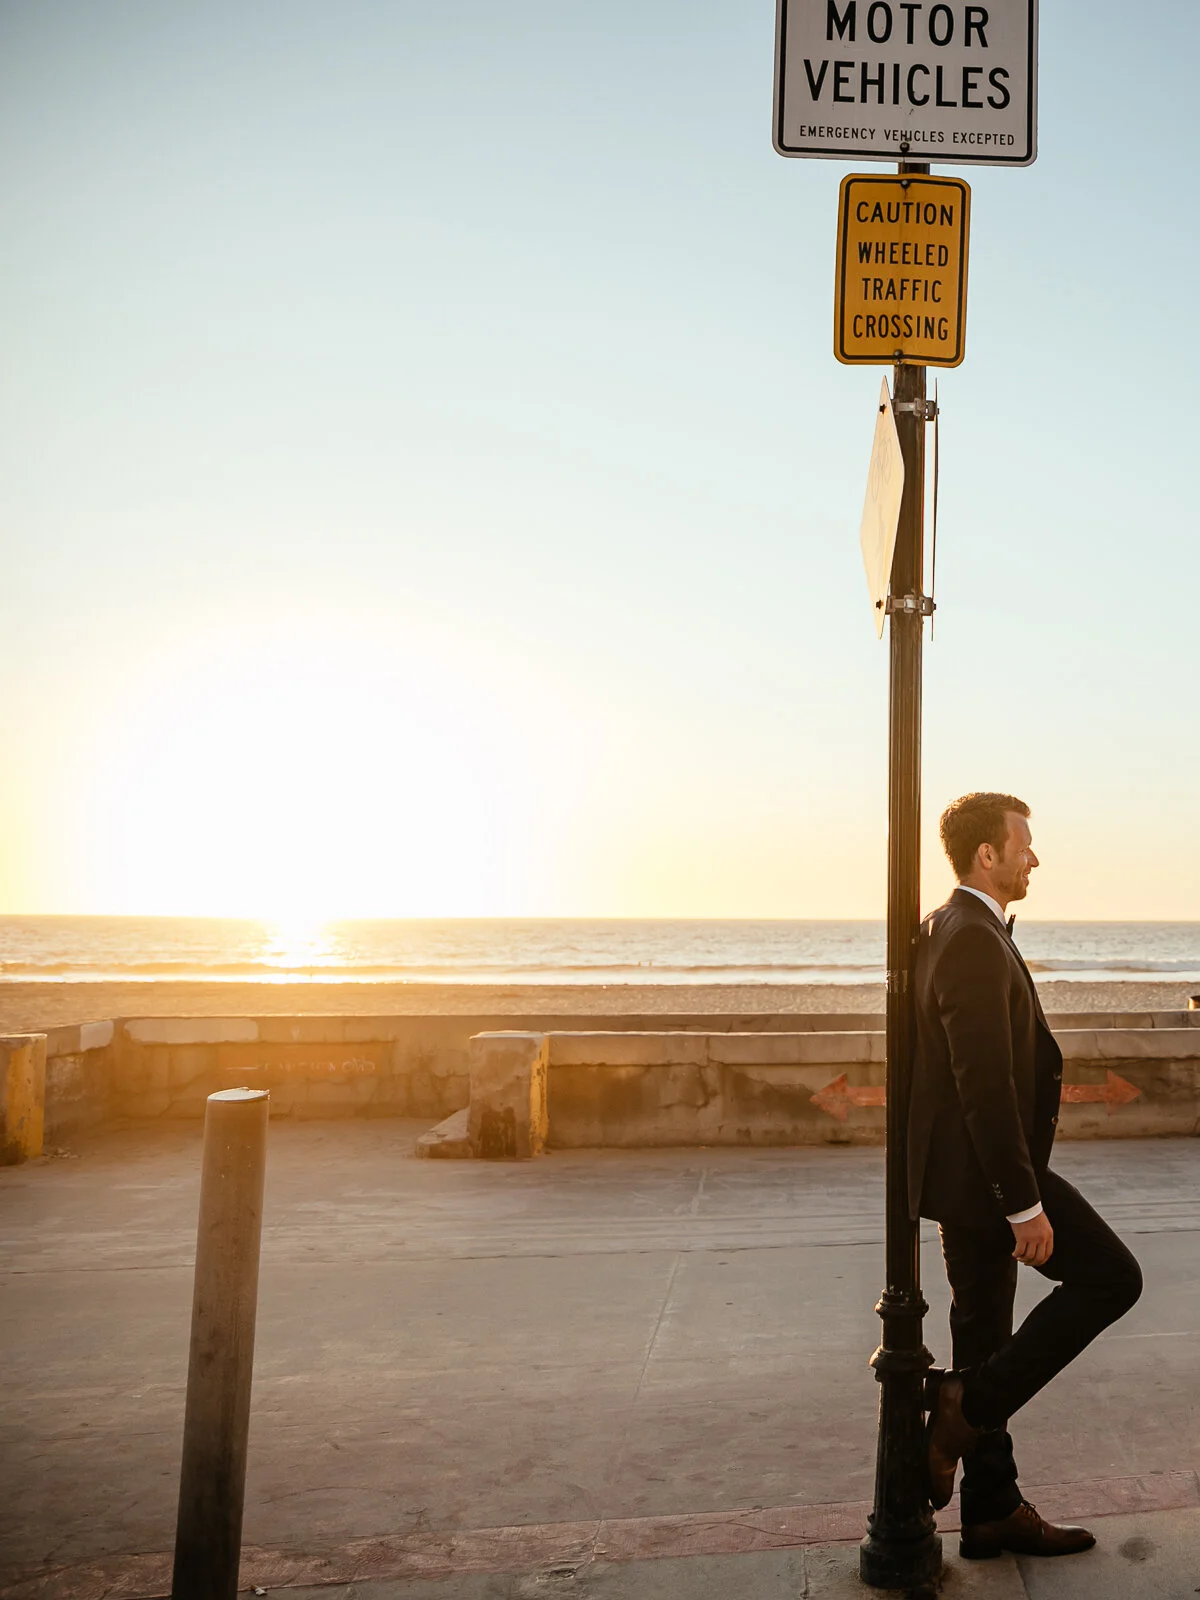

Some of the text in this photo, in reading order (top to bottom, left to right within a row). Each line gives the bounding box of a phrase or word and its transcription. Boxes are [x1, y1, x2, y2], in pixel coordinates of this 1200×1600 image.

[826, 0, 989, 48] MOTOR
[803, 59, 1011, 110] VEHICLES
[800, 125, 1015, 146] EMERGENCY VEHICLES EXCEPTED
[856, 201, 954, 227] CAUTION
[858, 241, 949, 267] WHEELED
[862, 277, 942, 303] TRAFFIC
[853, 314, 949, 341] CROSSING
